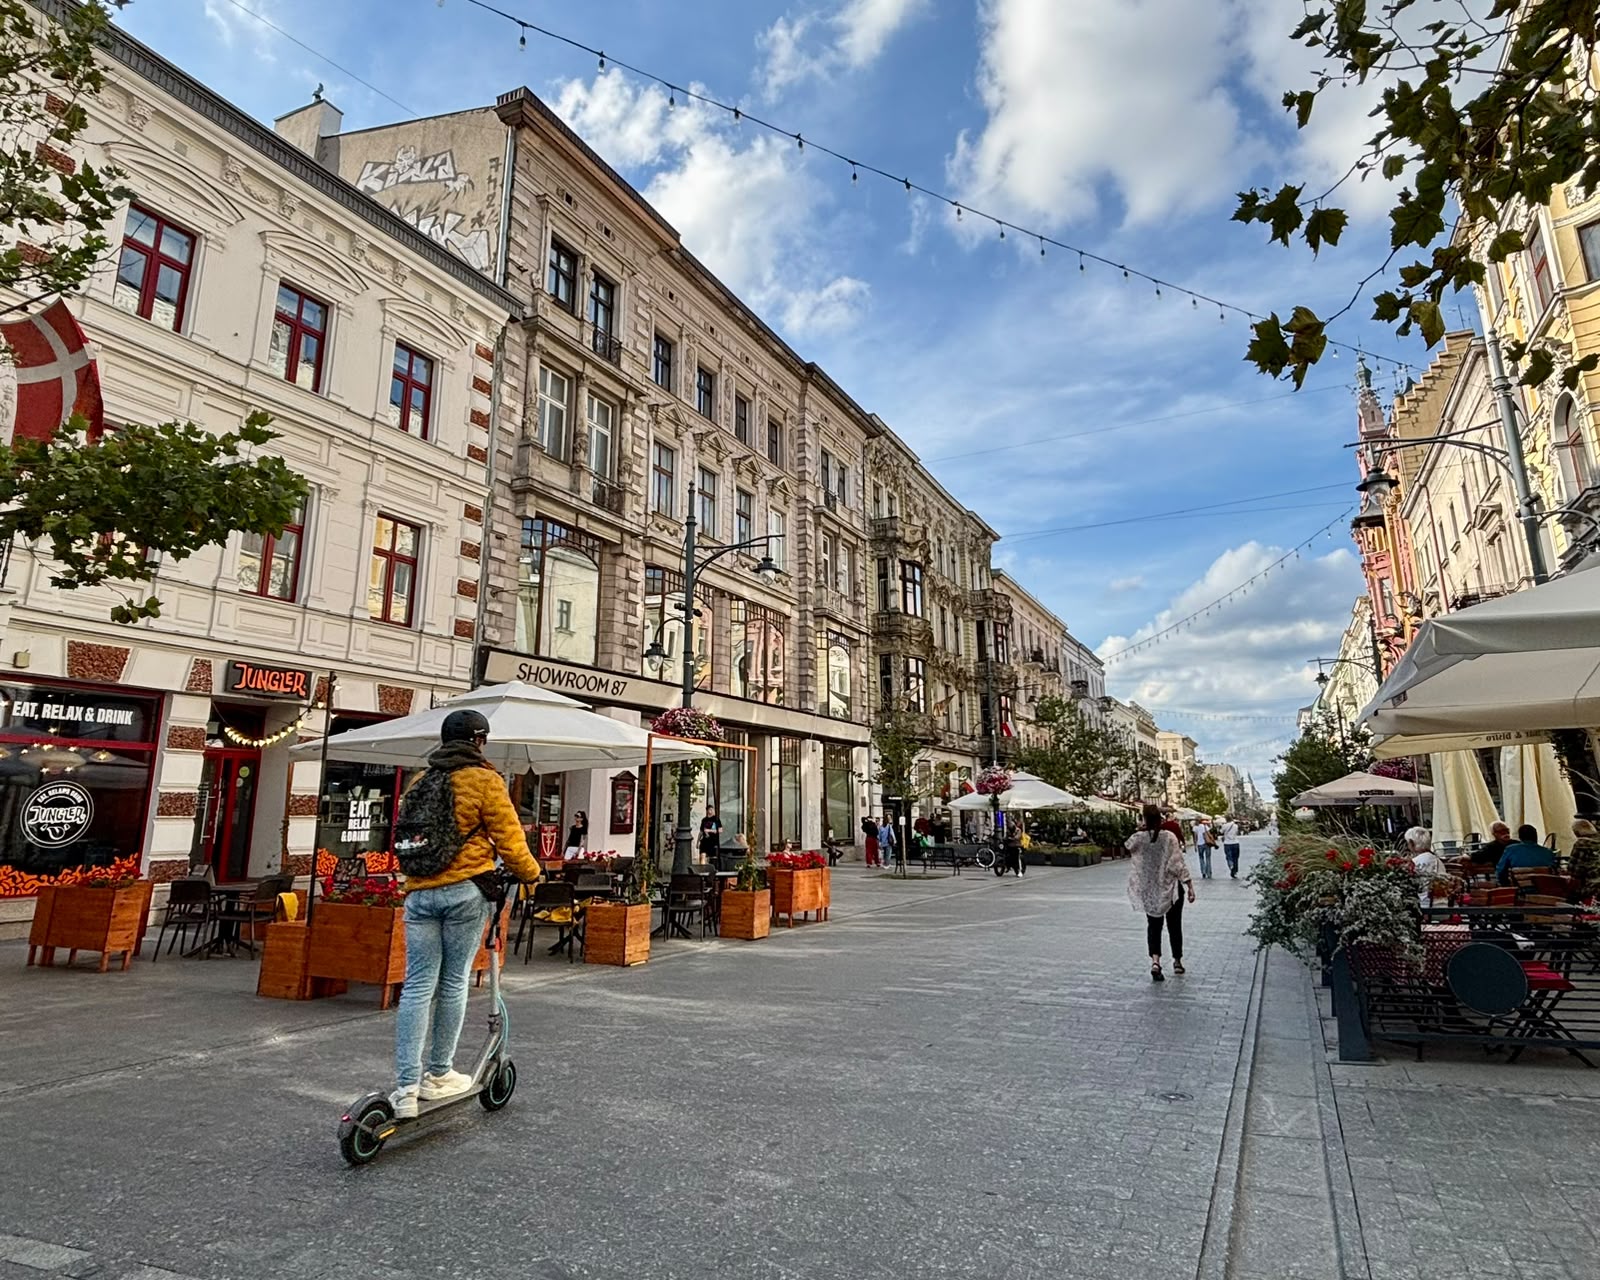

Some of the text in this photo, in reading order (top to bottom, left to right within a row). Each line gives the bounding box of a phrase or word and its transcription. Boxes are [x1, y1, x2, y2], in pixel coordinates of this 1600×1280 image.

[233, 663, 306, 697] JUNGLER
[516, 663, 628, 696] SHOWROOM 87
[12, 701, 133, 725] EAT, RELAX & DRINK
[27, 806, 86, 824] JUNGLER
